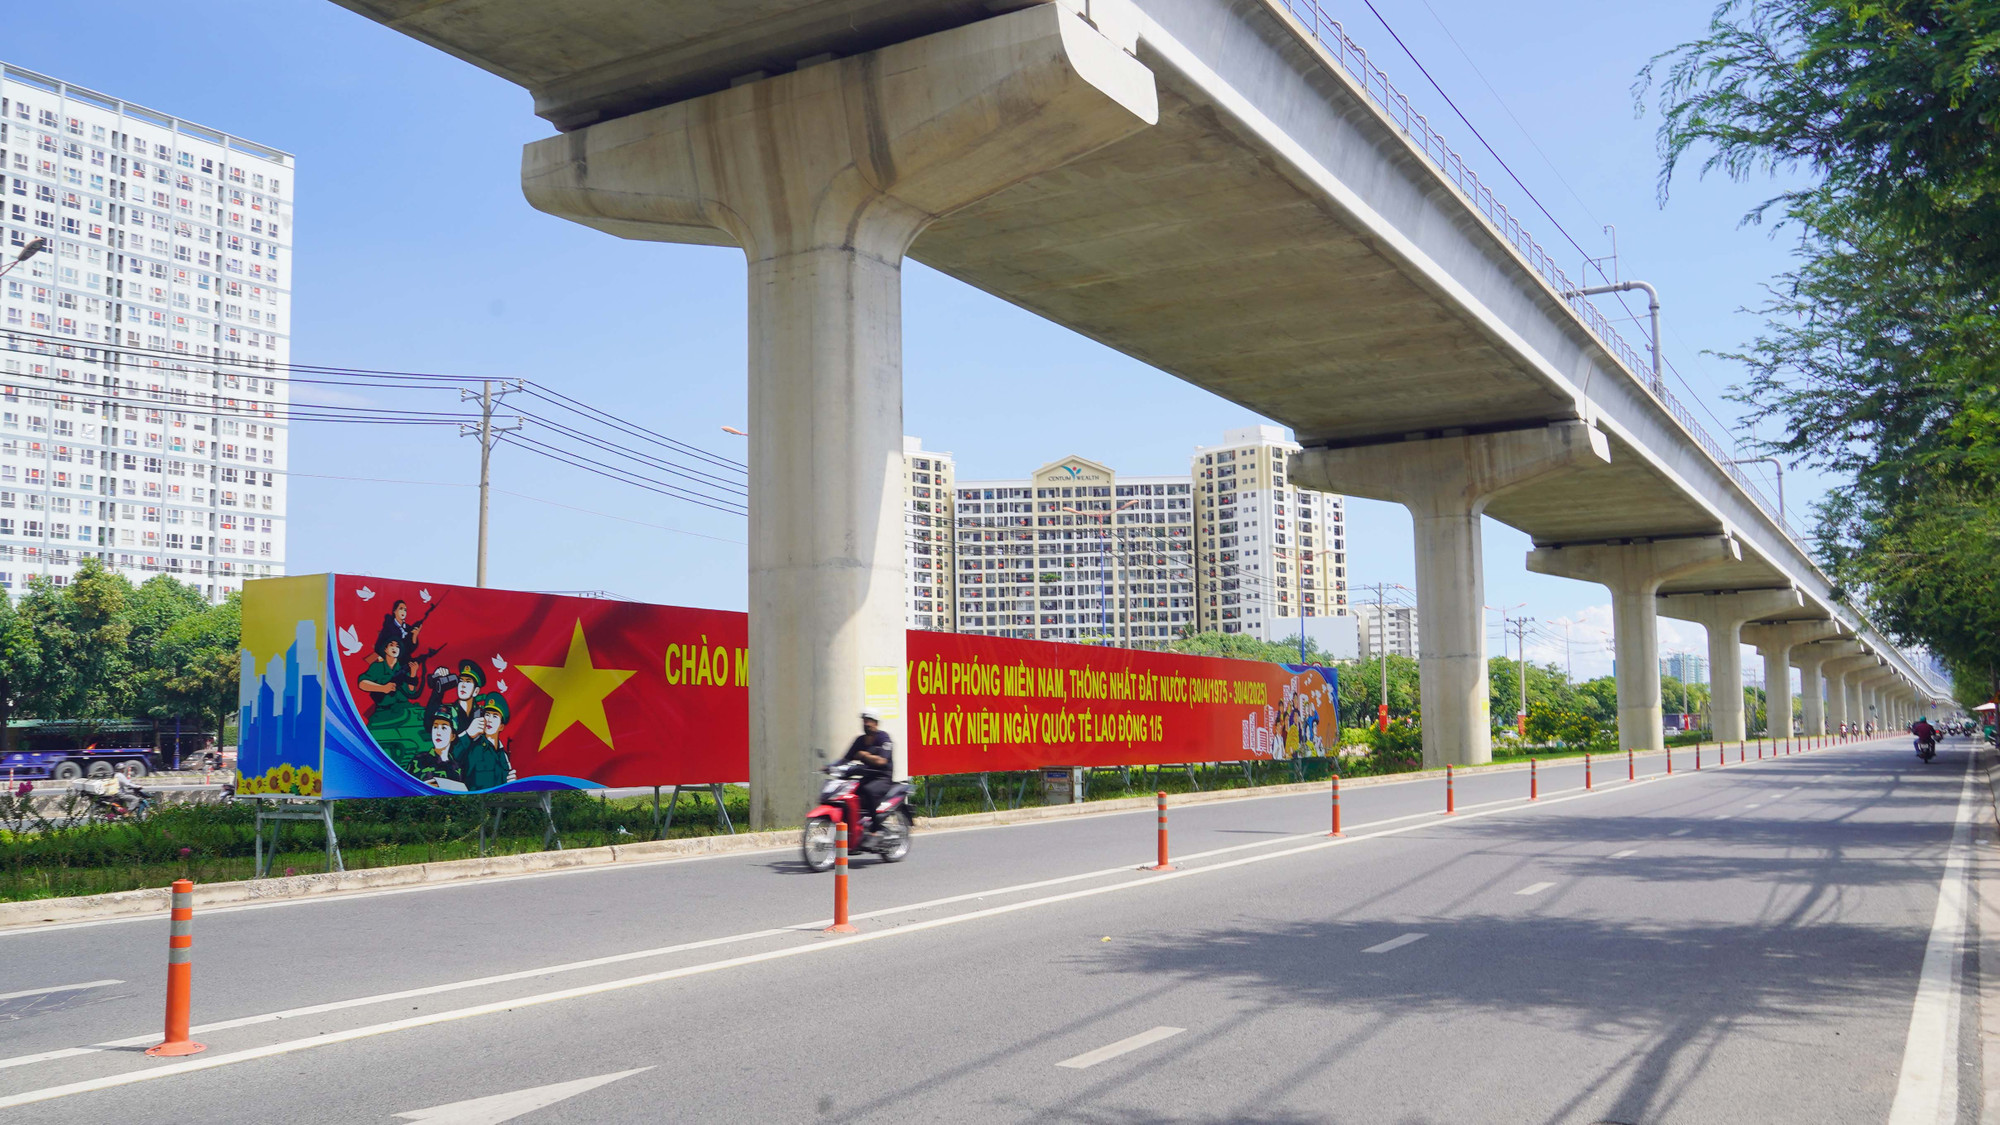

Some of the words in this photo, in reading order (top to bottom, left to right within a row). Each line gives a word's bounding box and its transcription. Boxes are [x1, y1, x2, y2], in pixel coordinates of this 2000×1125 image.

[665, 634, 729, 687] CHÀO
[917, 653, 948, 695] GIẢI
[951, 654, 1001, 697] PHÓNG
[1003, 659, 1035, 698] MIỀN
[1037, 667, 1067, 703] NAM,
[1069, 663, 1108, 700] THỐNG
[1109, 666, 1137, 701] NHẤT
[1138, 668, 1159, 702] ĐẤT
[1160, 669, 1188, 703] NƯỚC
[1189, 677, 1228, 709] (30/4/1975
[1233, 680, 1268, 707] 30/4/2025)
[918, 702, 941, 746] VÀ
[943, 704, 964, 745] KỶ
[967, 706, 1000, 752] NIỆM
[1003, 704, 1039, 744] NGÀY
[1041, 706, 1076, 745] QUỐC
[1077, 706, 1093, 743] TẾ
[1094, 713, 1117, 743] LAO
[1117, 709, 1148, 749] ĐỘNG
[1149, 714, 1163, 742] 1/5
